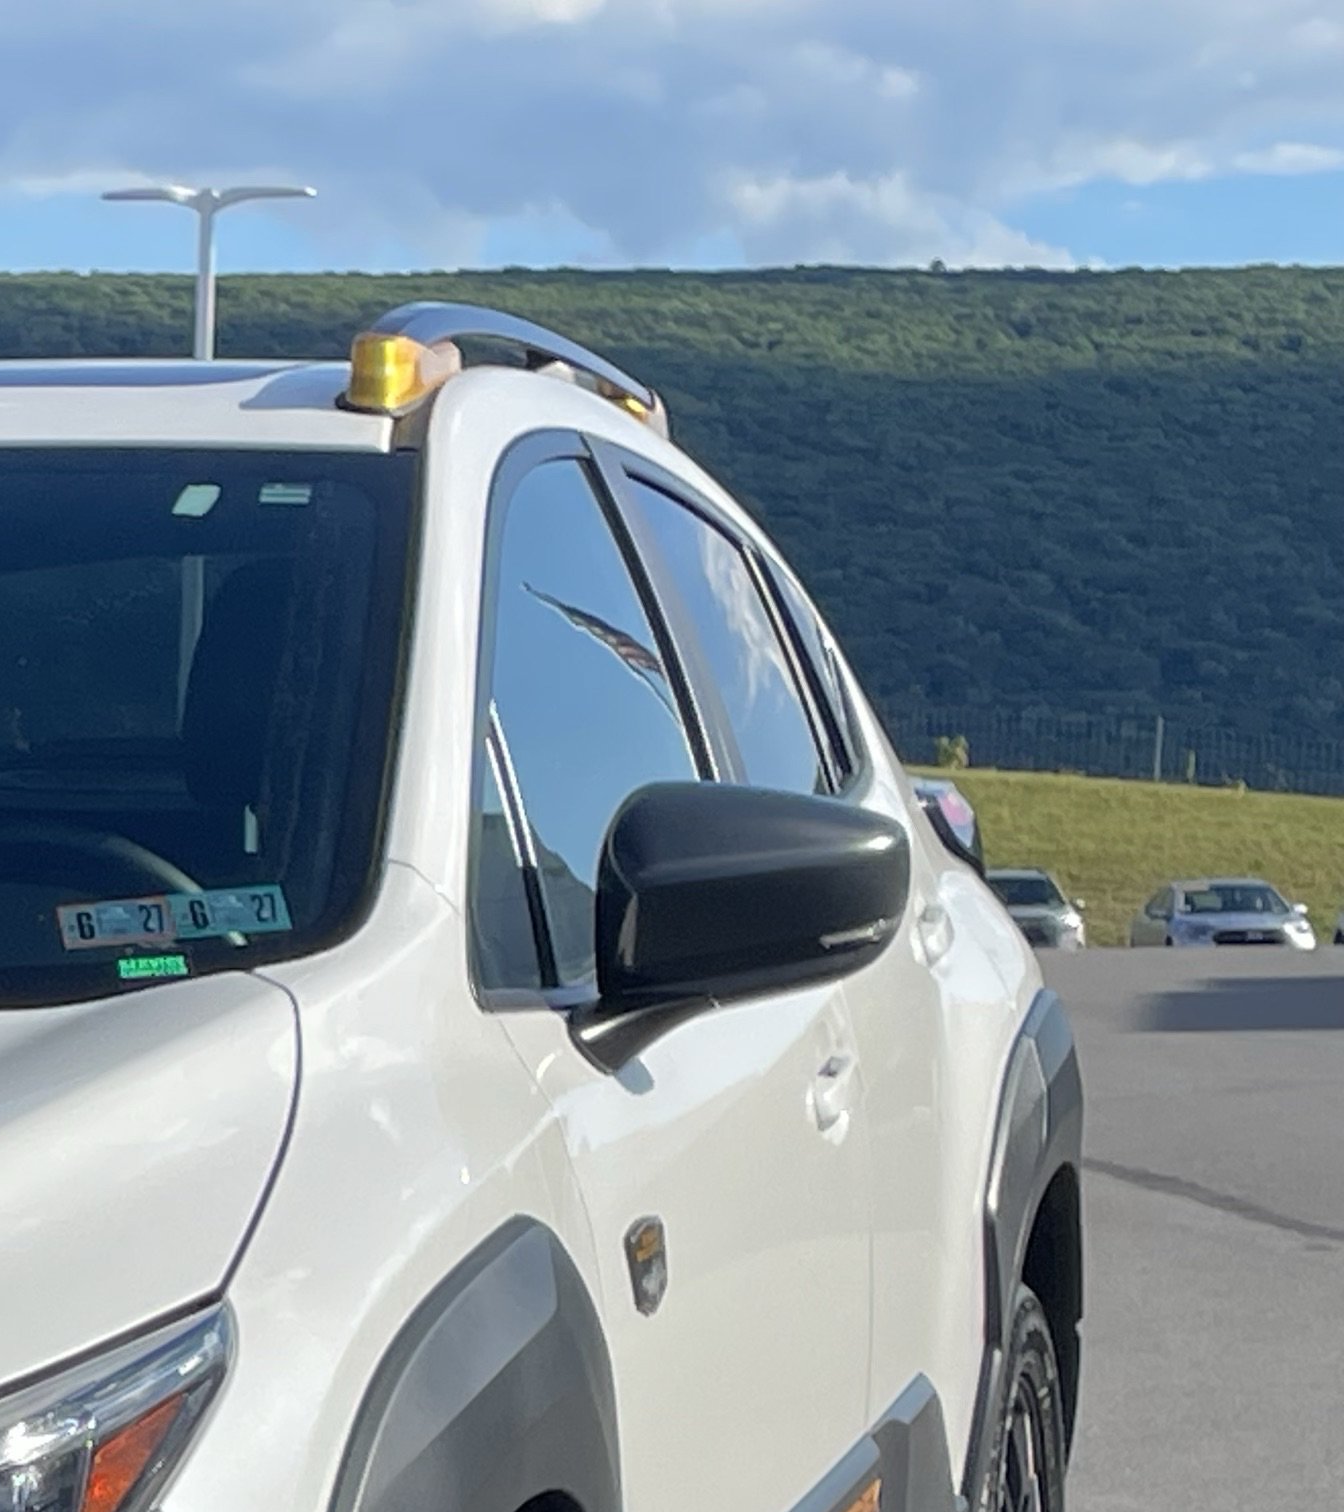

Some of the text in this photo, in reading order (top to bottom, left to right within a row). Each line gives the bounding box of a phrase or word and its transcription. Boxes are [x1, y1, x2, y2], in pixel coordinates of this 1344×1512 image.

[76, 903, 165, 940] 6 27
[189, 893, 278, 930] 6 27
